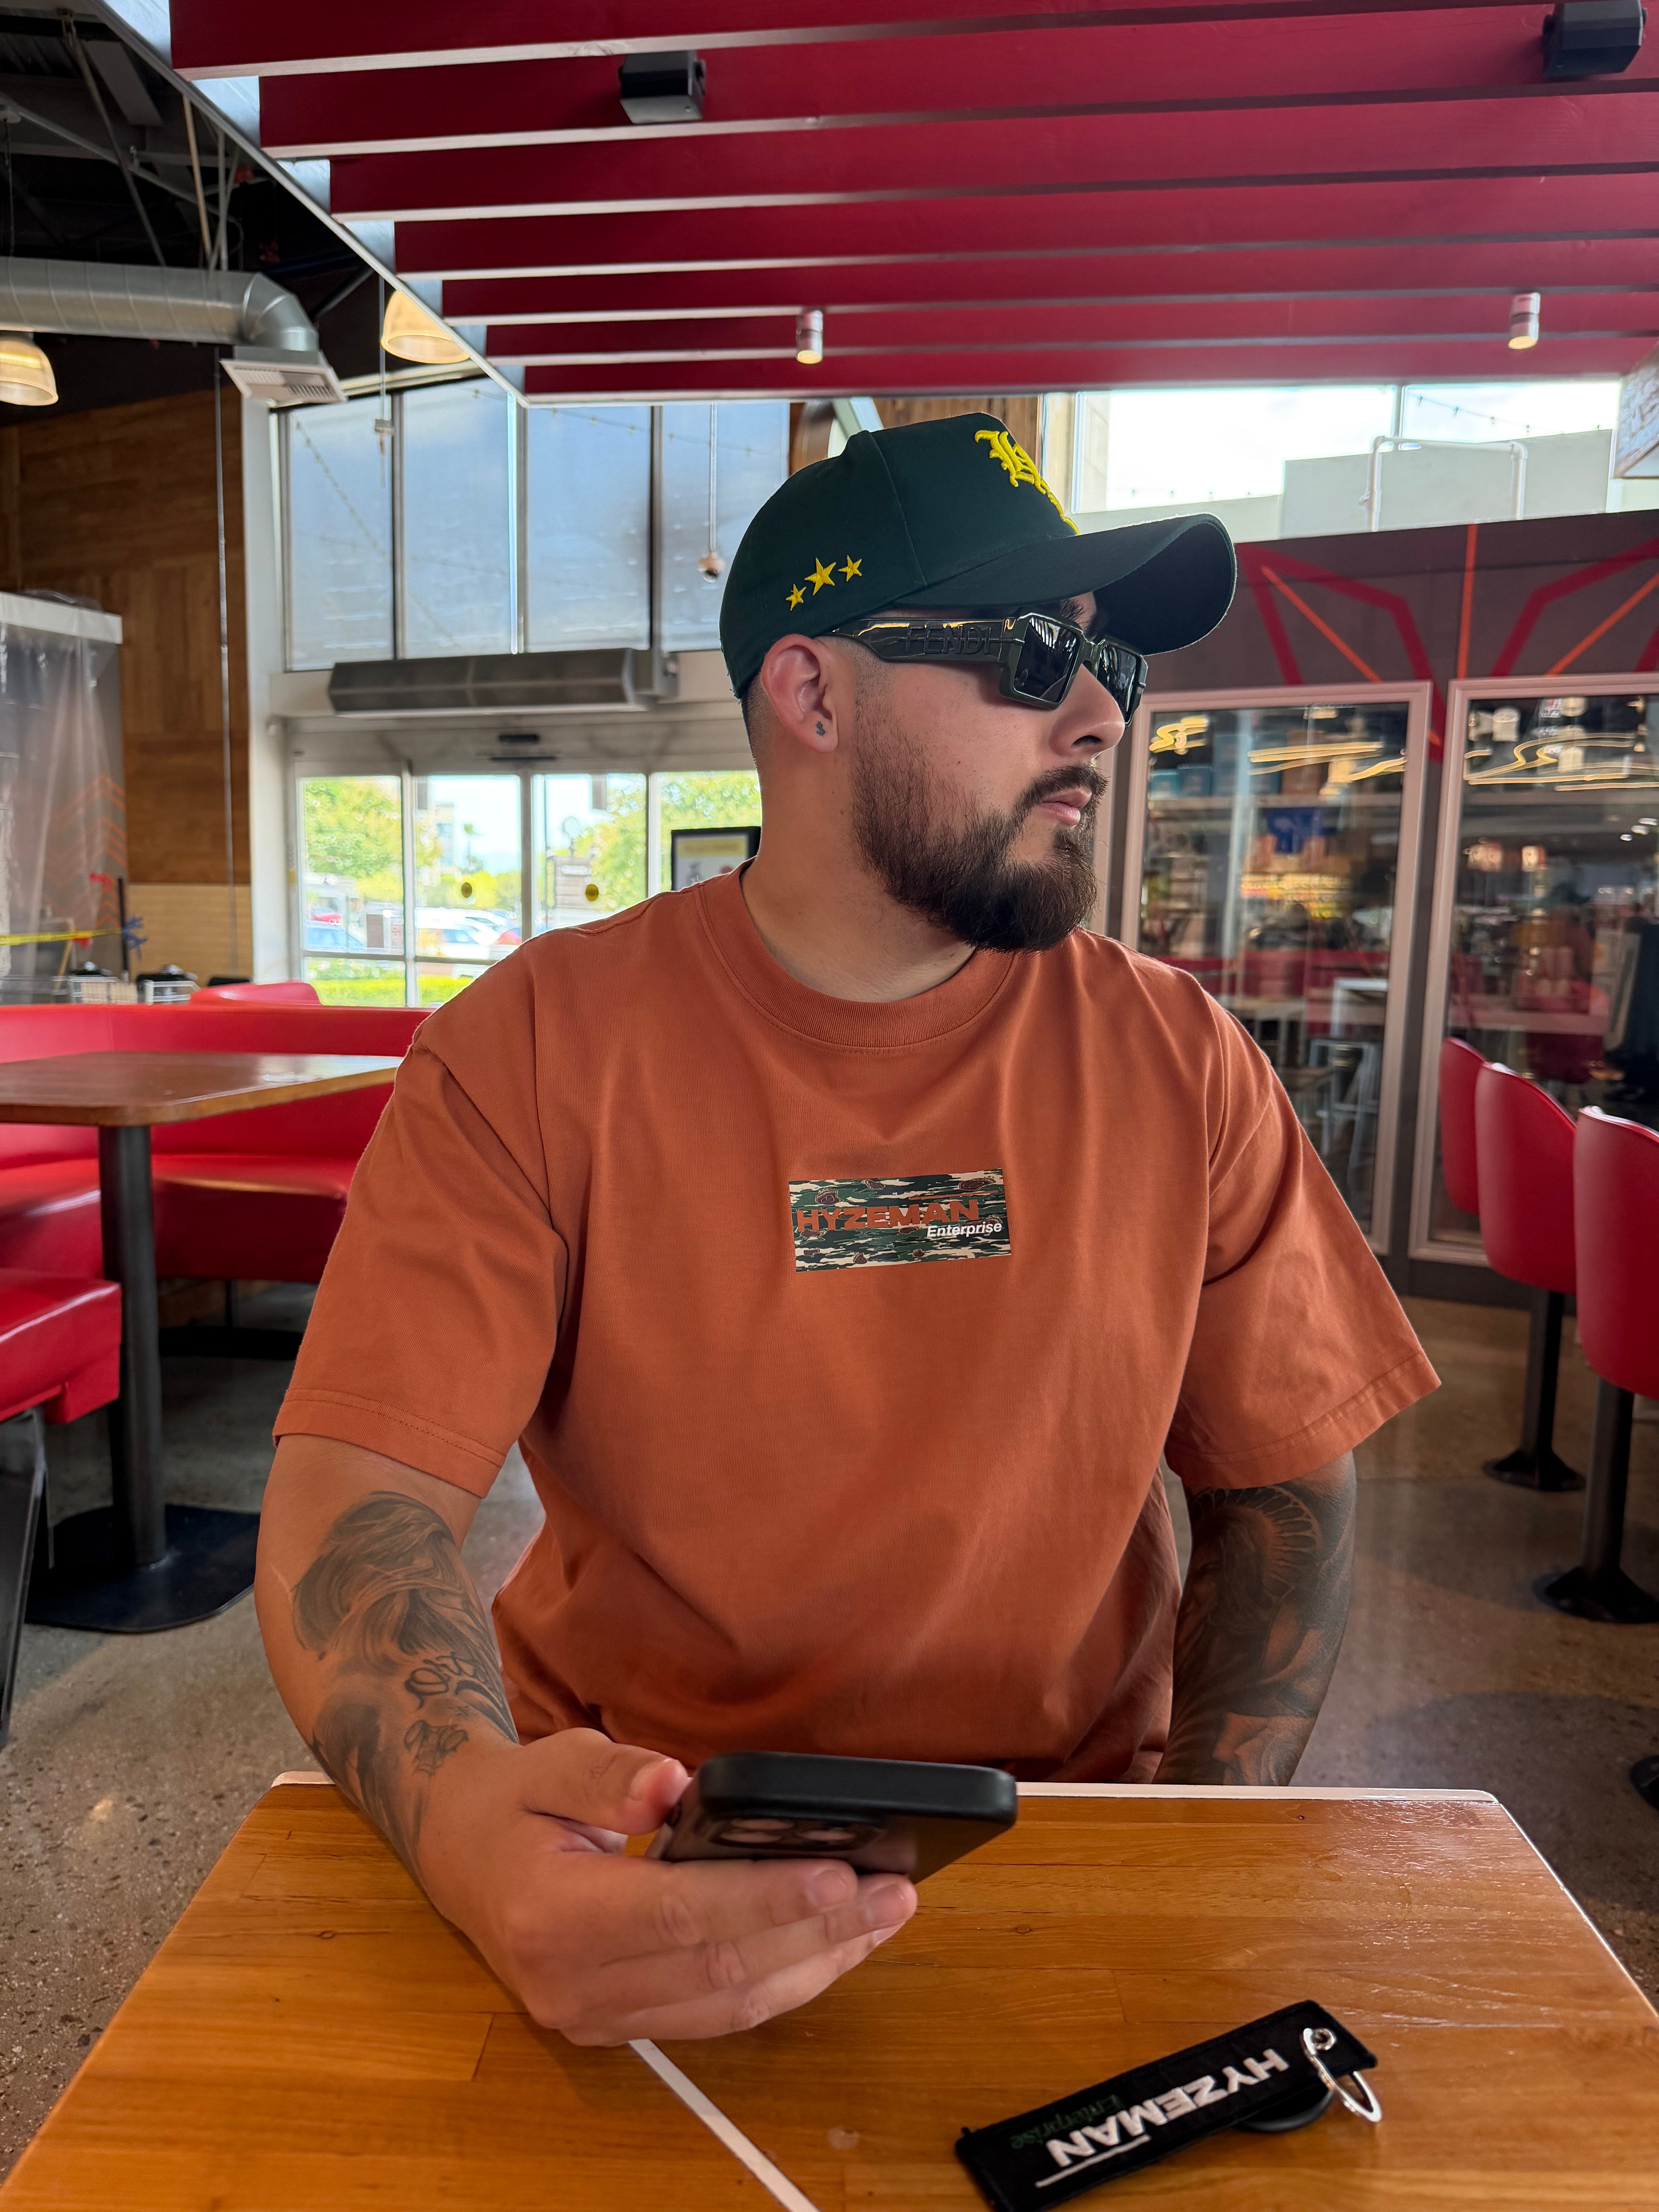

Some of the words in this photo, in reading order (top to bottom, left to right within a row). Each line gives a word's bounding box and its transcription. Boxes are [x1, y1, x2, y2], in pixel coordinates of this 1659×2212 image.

[905, 621, 991, 654] FENDI
[797, 1200, 979, 1233] HYZEMAN
[926, 1223, 1003, 1238] Enterprise
[1046, 2049, 1289, 2167] HYZEMAN
